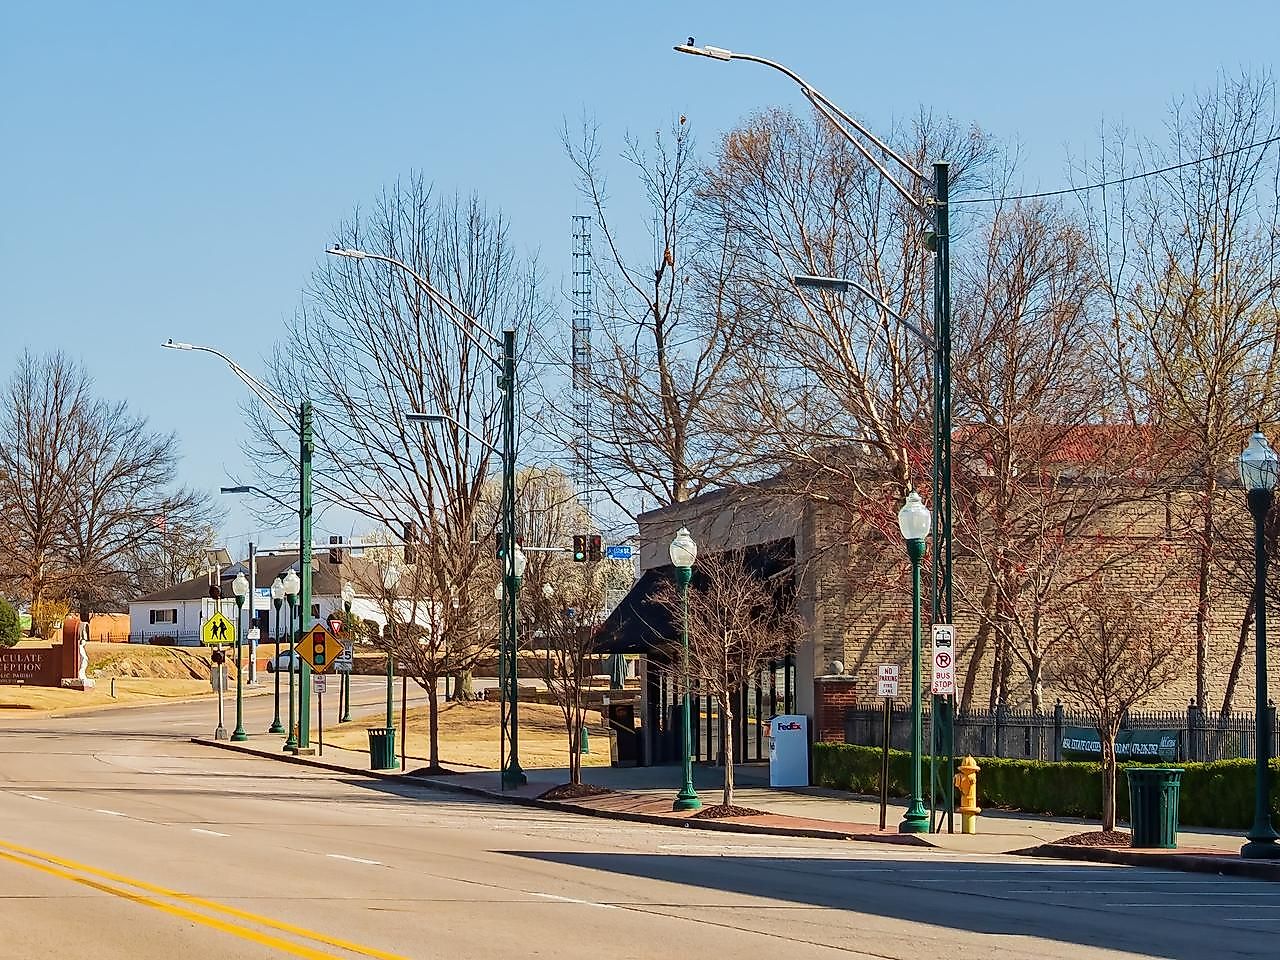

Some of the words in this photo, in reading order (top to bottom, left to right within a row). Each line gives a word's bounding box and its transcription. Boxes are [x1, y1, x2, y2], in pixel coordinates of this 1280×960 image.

[884, 667, 893, 675] NO
[935, 672, 951, 680] BUS
[934, 680, 953, 688] STOP
[777, 722, 802, 731] FedEx
